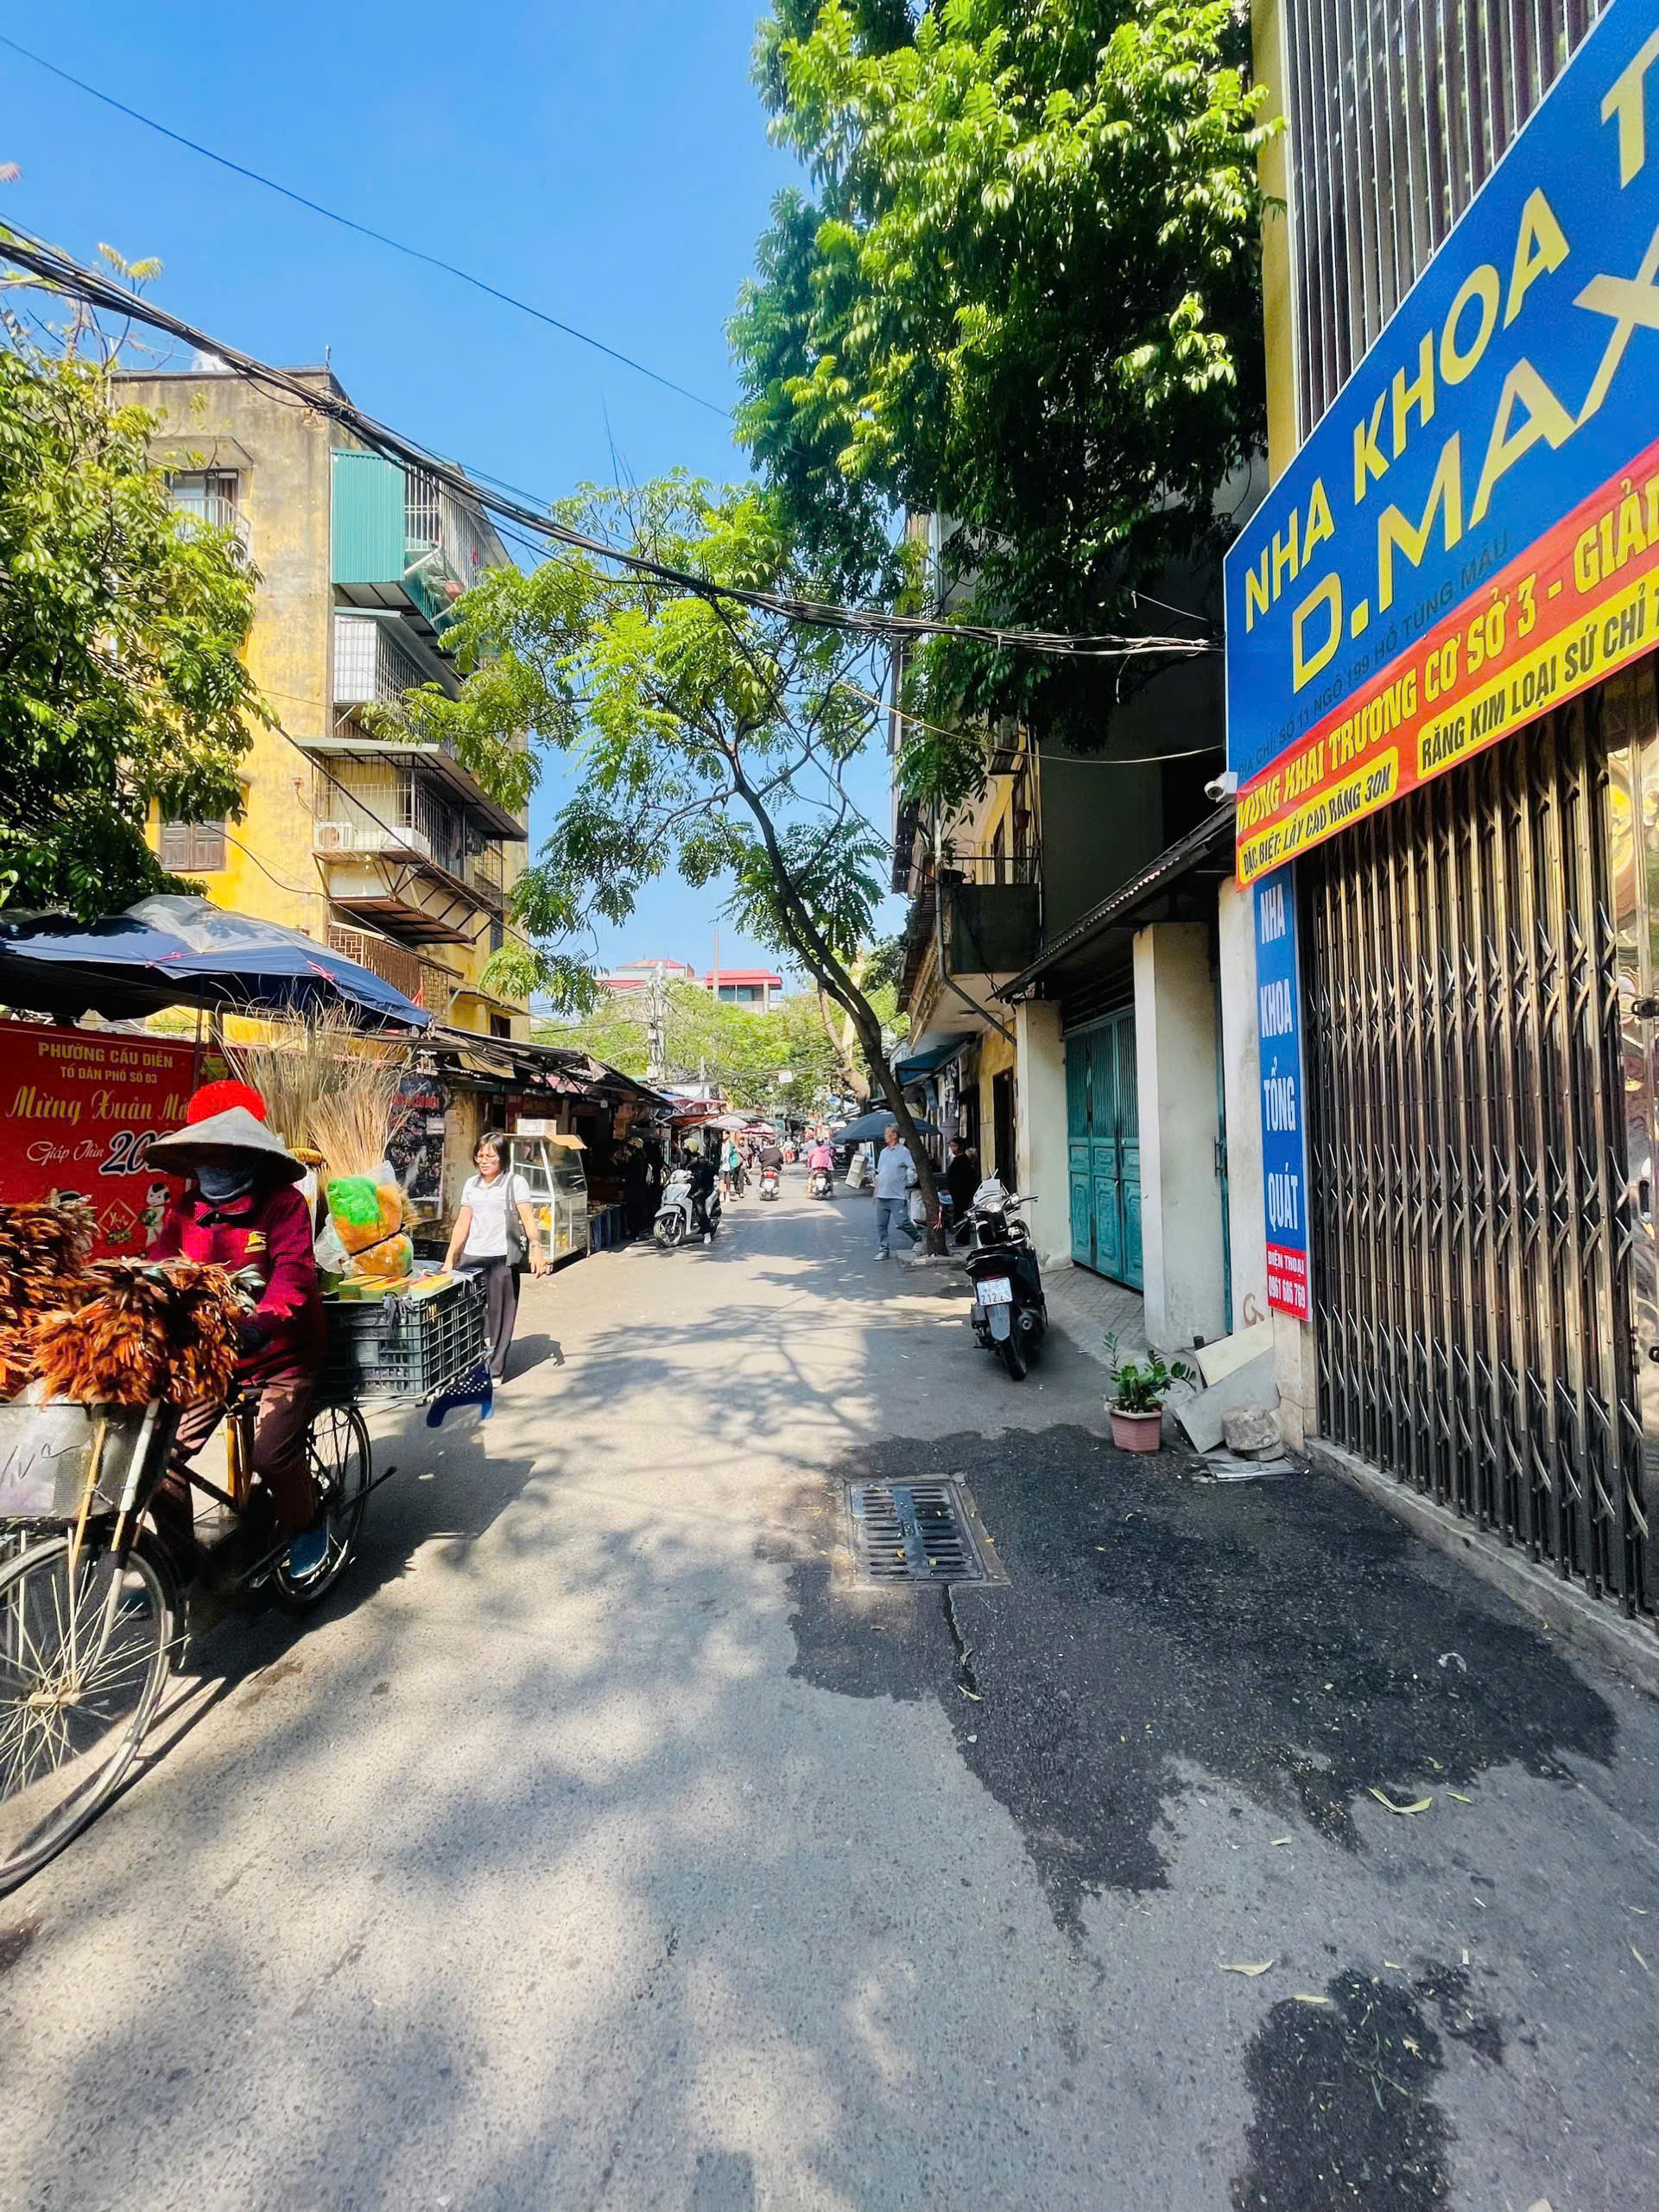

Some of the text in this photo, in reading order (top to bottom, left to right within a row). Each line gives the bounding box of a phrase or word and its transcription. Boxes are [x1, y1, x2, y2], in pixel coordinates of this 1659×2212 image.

[1245, 477, 1335, 635] NHA
[1353, 187, 1571, 506] KHOA
[1283, 738, 1326, 804] KHAI
[1328, 666, 1417, 772] TRƯƠNG
[1425, 631, 1461, 704] CƠ
[1466, 586, 1510, 676] SỞ
[1517, 573, 1538, 640] 3
[1347, 654, 1370, 688] 199
[1422, 715, 1466, 771] RĂNG
[1470, 688, 1506, 742] KIM
[1510, 655, 1556, 717] LOẠI
[1564, 623, 1598, 682] SỨ
[1603, 582, 1646, 659] CHỈ
[1243, 846, 1258, 878] ĐẶC
[1283, 813, 1304, 851] LẤY
[1306, 804, 1327, 839] CAO
[1328, 781, 1362, 825] RĂNG
[1365, 763, 1391, 803] 30K
[1260, 883, 1285, 944] NHA
[1260, 978, 1293, 1037] KHOA
[38, 1042, 104, 1062] PHƯỜNG
[78, 1066, 102, 1081] DÂN
[145, 1074, 158, 1084] 03
[5, 1085, 82, 1125] Mừng
[91, 1089, 155, 1120] Xuân
[1263, 1056, 1296, 1131] TỔNG
[27, 1141, 70, 1166] Giáp
[73, 1139, 104, 1162] Thìn
[1267, 1162, 1299, 1233] QUÁT
[1283, 1254, 1305, 1277] THOẠI
